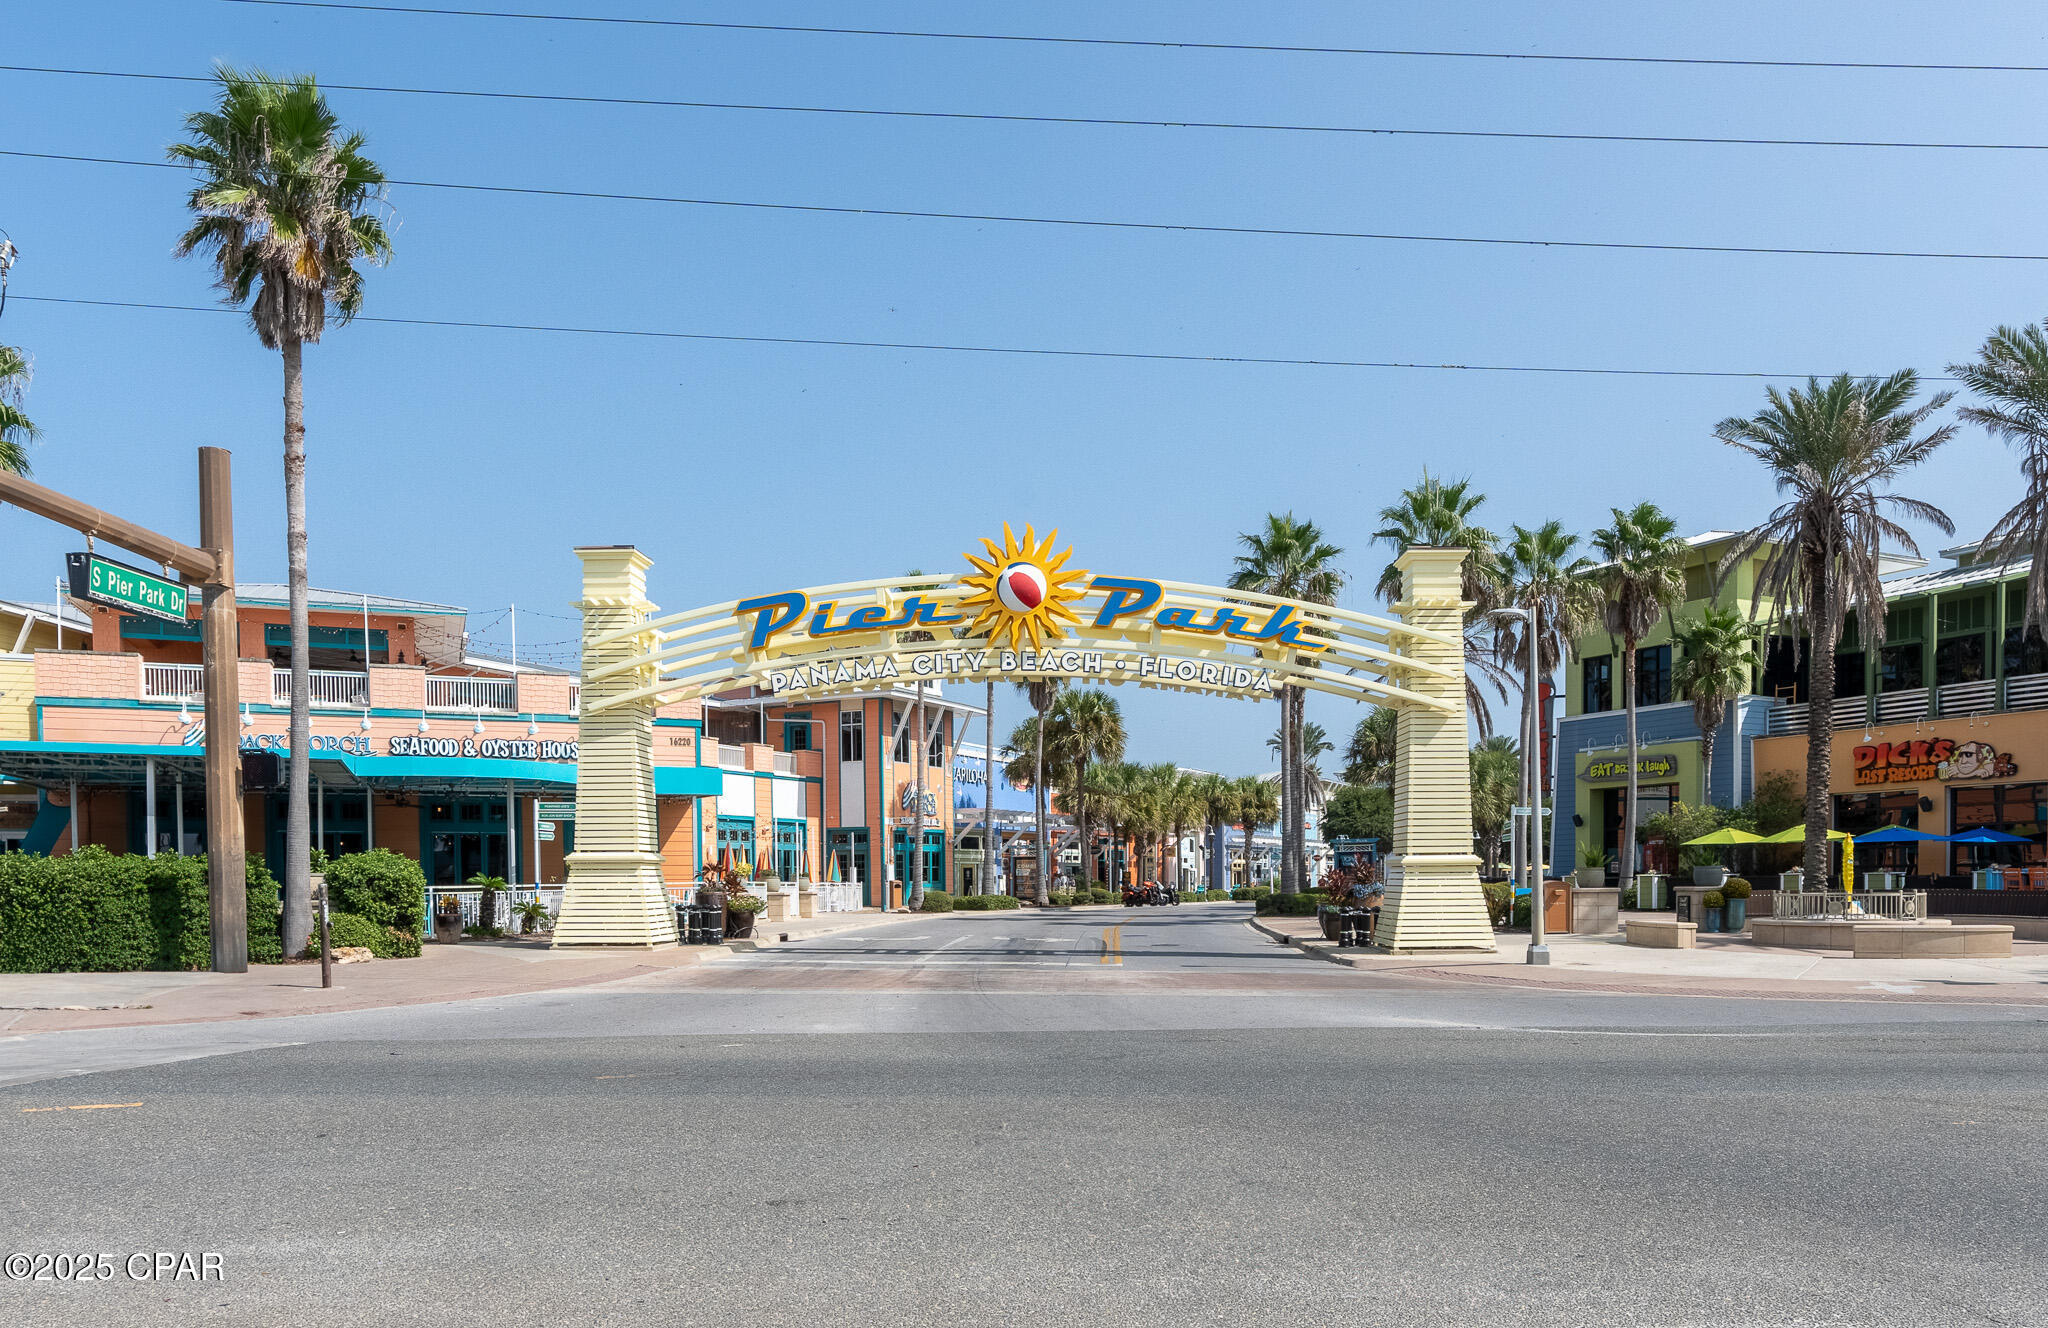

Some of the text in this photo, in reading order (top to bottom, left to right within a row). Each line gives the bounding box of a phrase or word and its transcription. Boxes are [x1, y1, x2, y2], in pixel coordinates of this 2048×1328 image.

[92, 566, 184, 612] S Pier Park Dr
[732, 575, 1331, 653] Pier Park
[771, 650, 1272, 693] PANAMA CITY BEACH FLORIDA
[308, 735, 375, 757] ORCH
[389, 735, 579, 760] SEAFOOD & OYSTER HOUS
[669, 737, 691, 746] 16220
[1853, 737, 1956, 769] DICK'S
[1590, 757, 1671, 778] EAT DRK laugh
[1855, 764, 1937, 785] LAST RESORT
